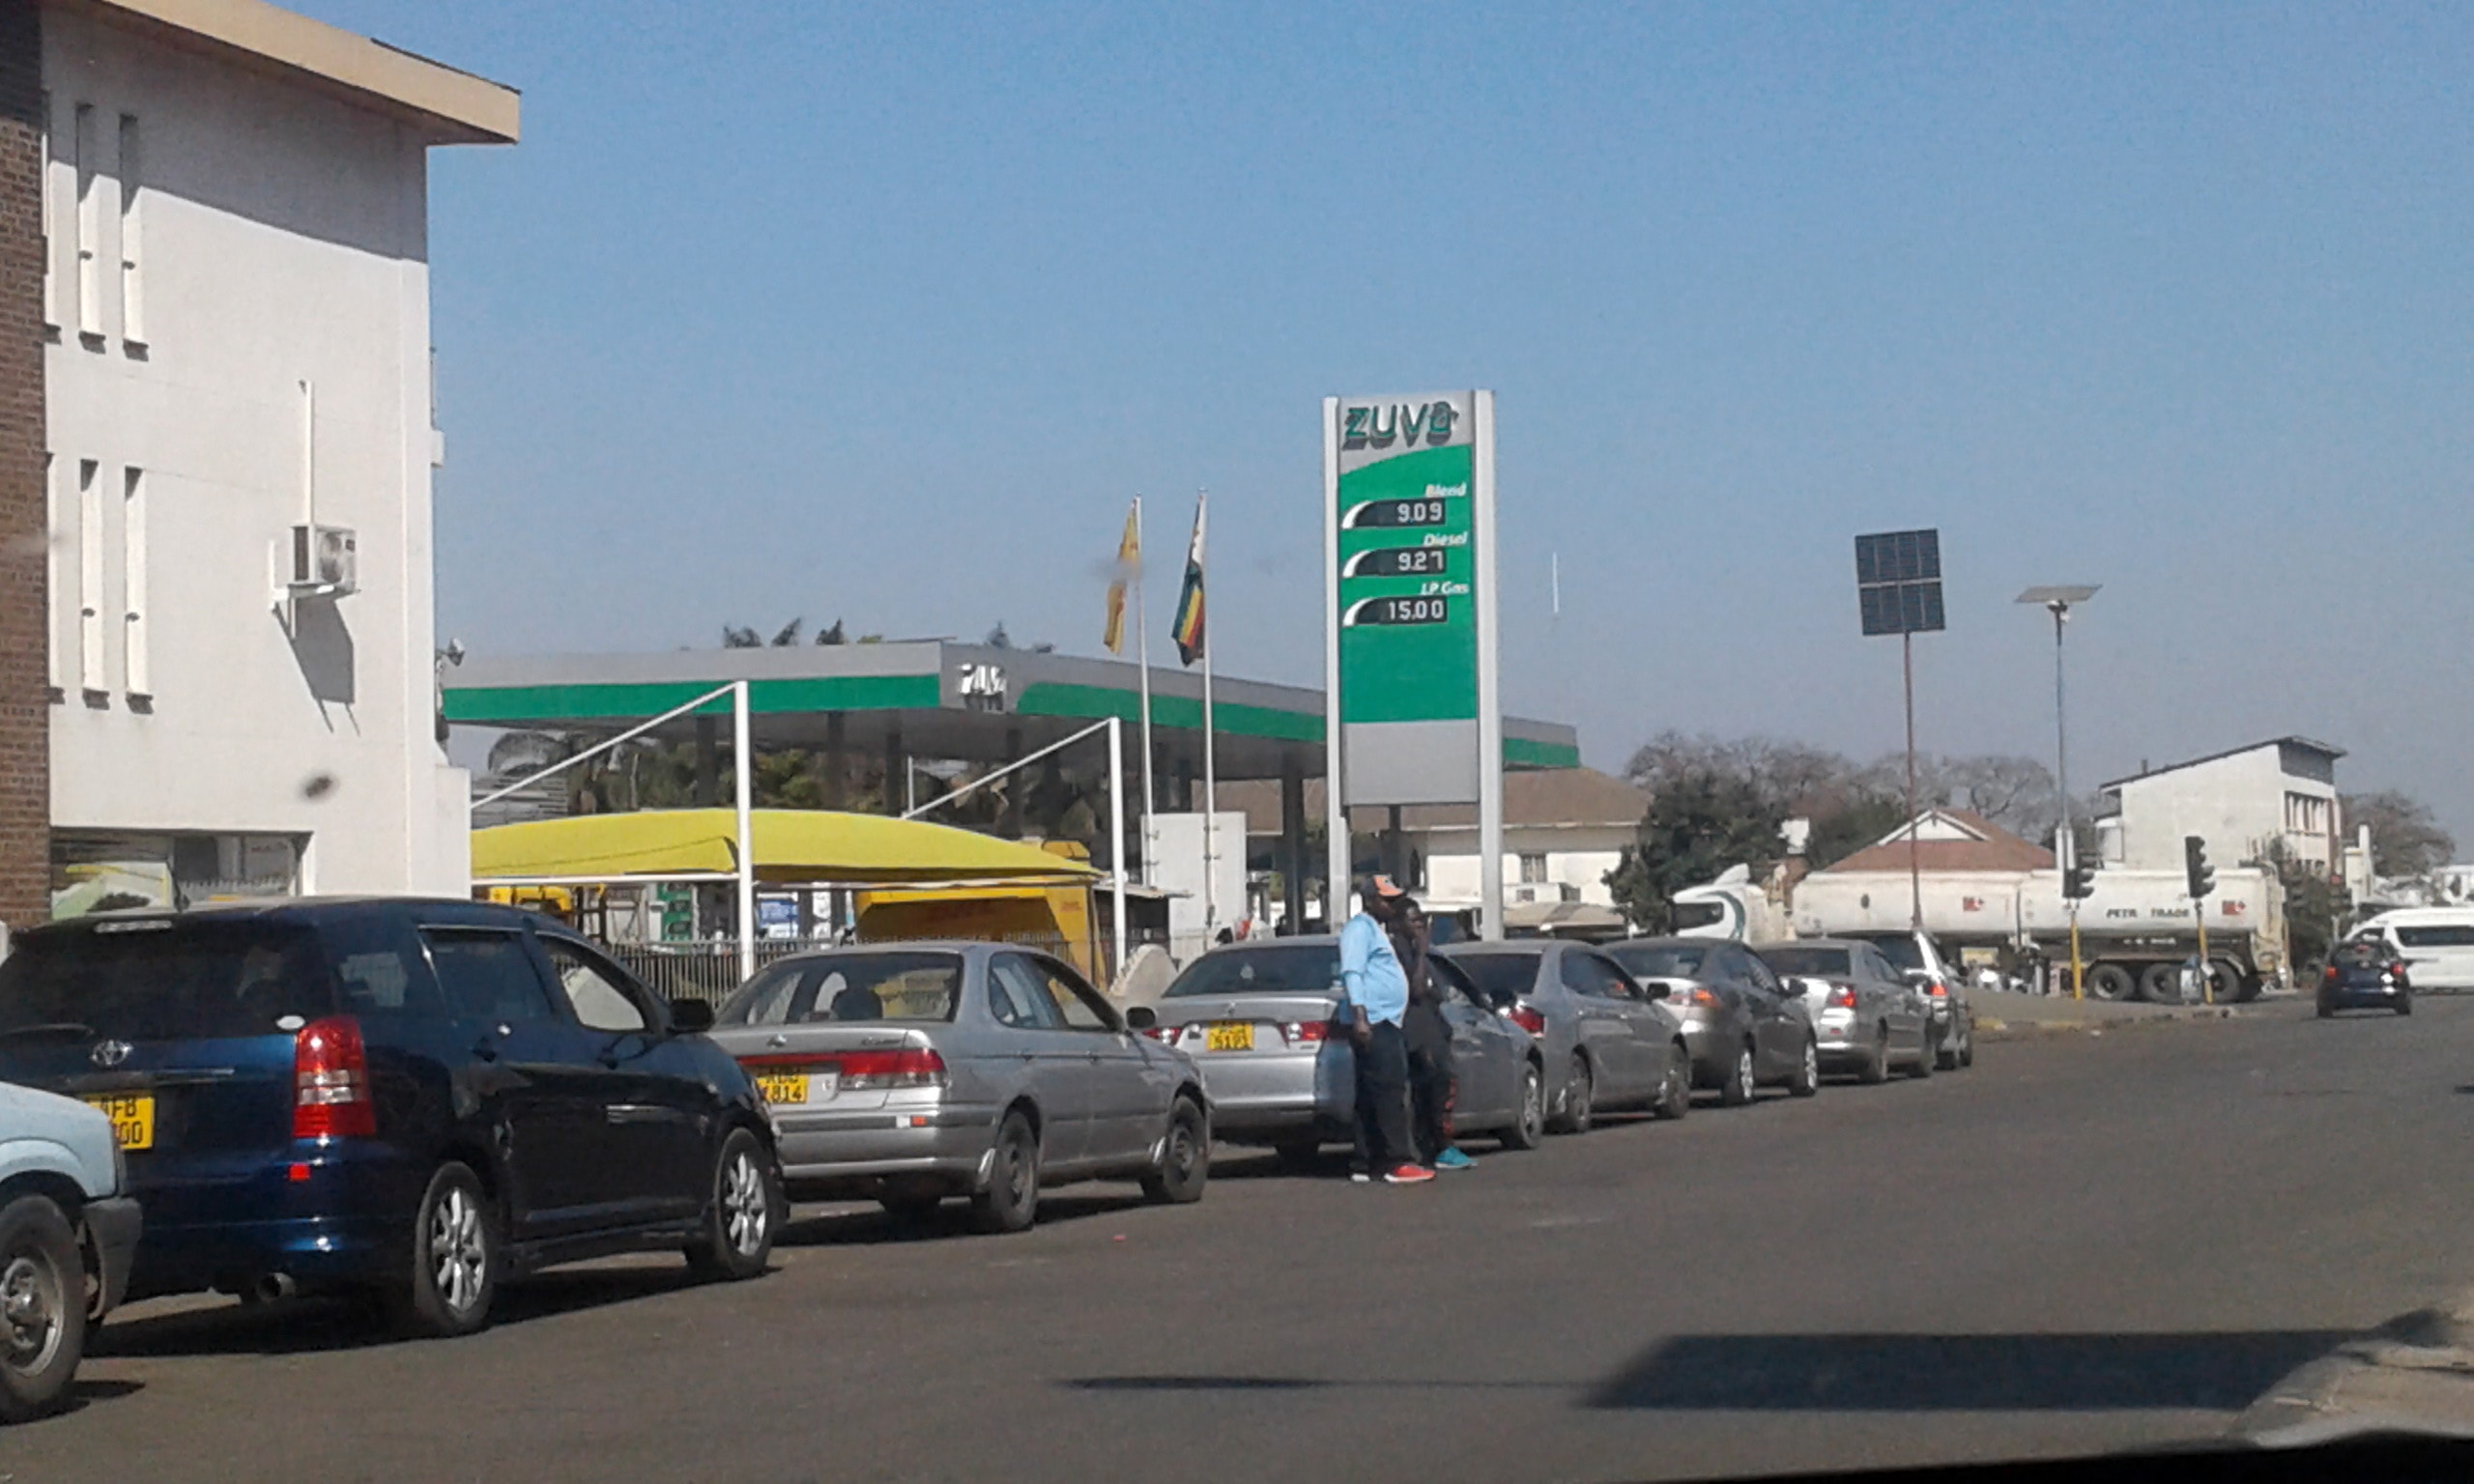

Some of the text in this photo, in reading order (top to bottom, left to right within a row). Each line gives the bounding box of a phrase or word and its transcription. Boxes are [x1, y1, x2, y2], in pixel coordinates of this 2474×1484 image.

[1425, 482, 1467, 498] Blend
[1396, 501, 1443, 523] 9.09
[1423, 531, 1469, 547] Diesel
[1441, 581, 1470, 594] Gas
[1389, 600, 1445, 620] 15.00
